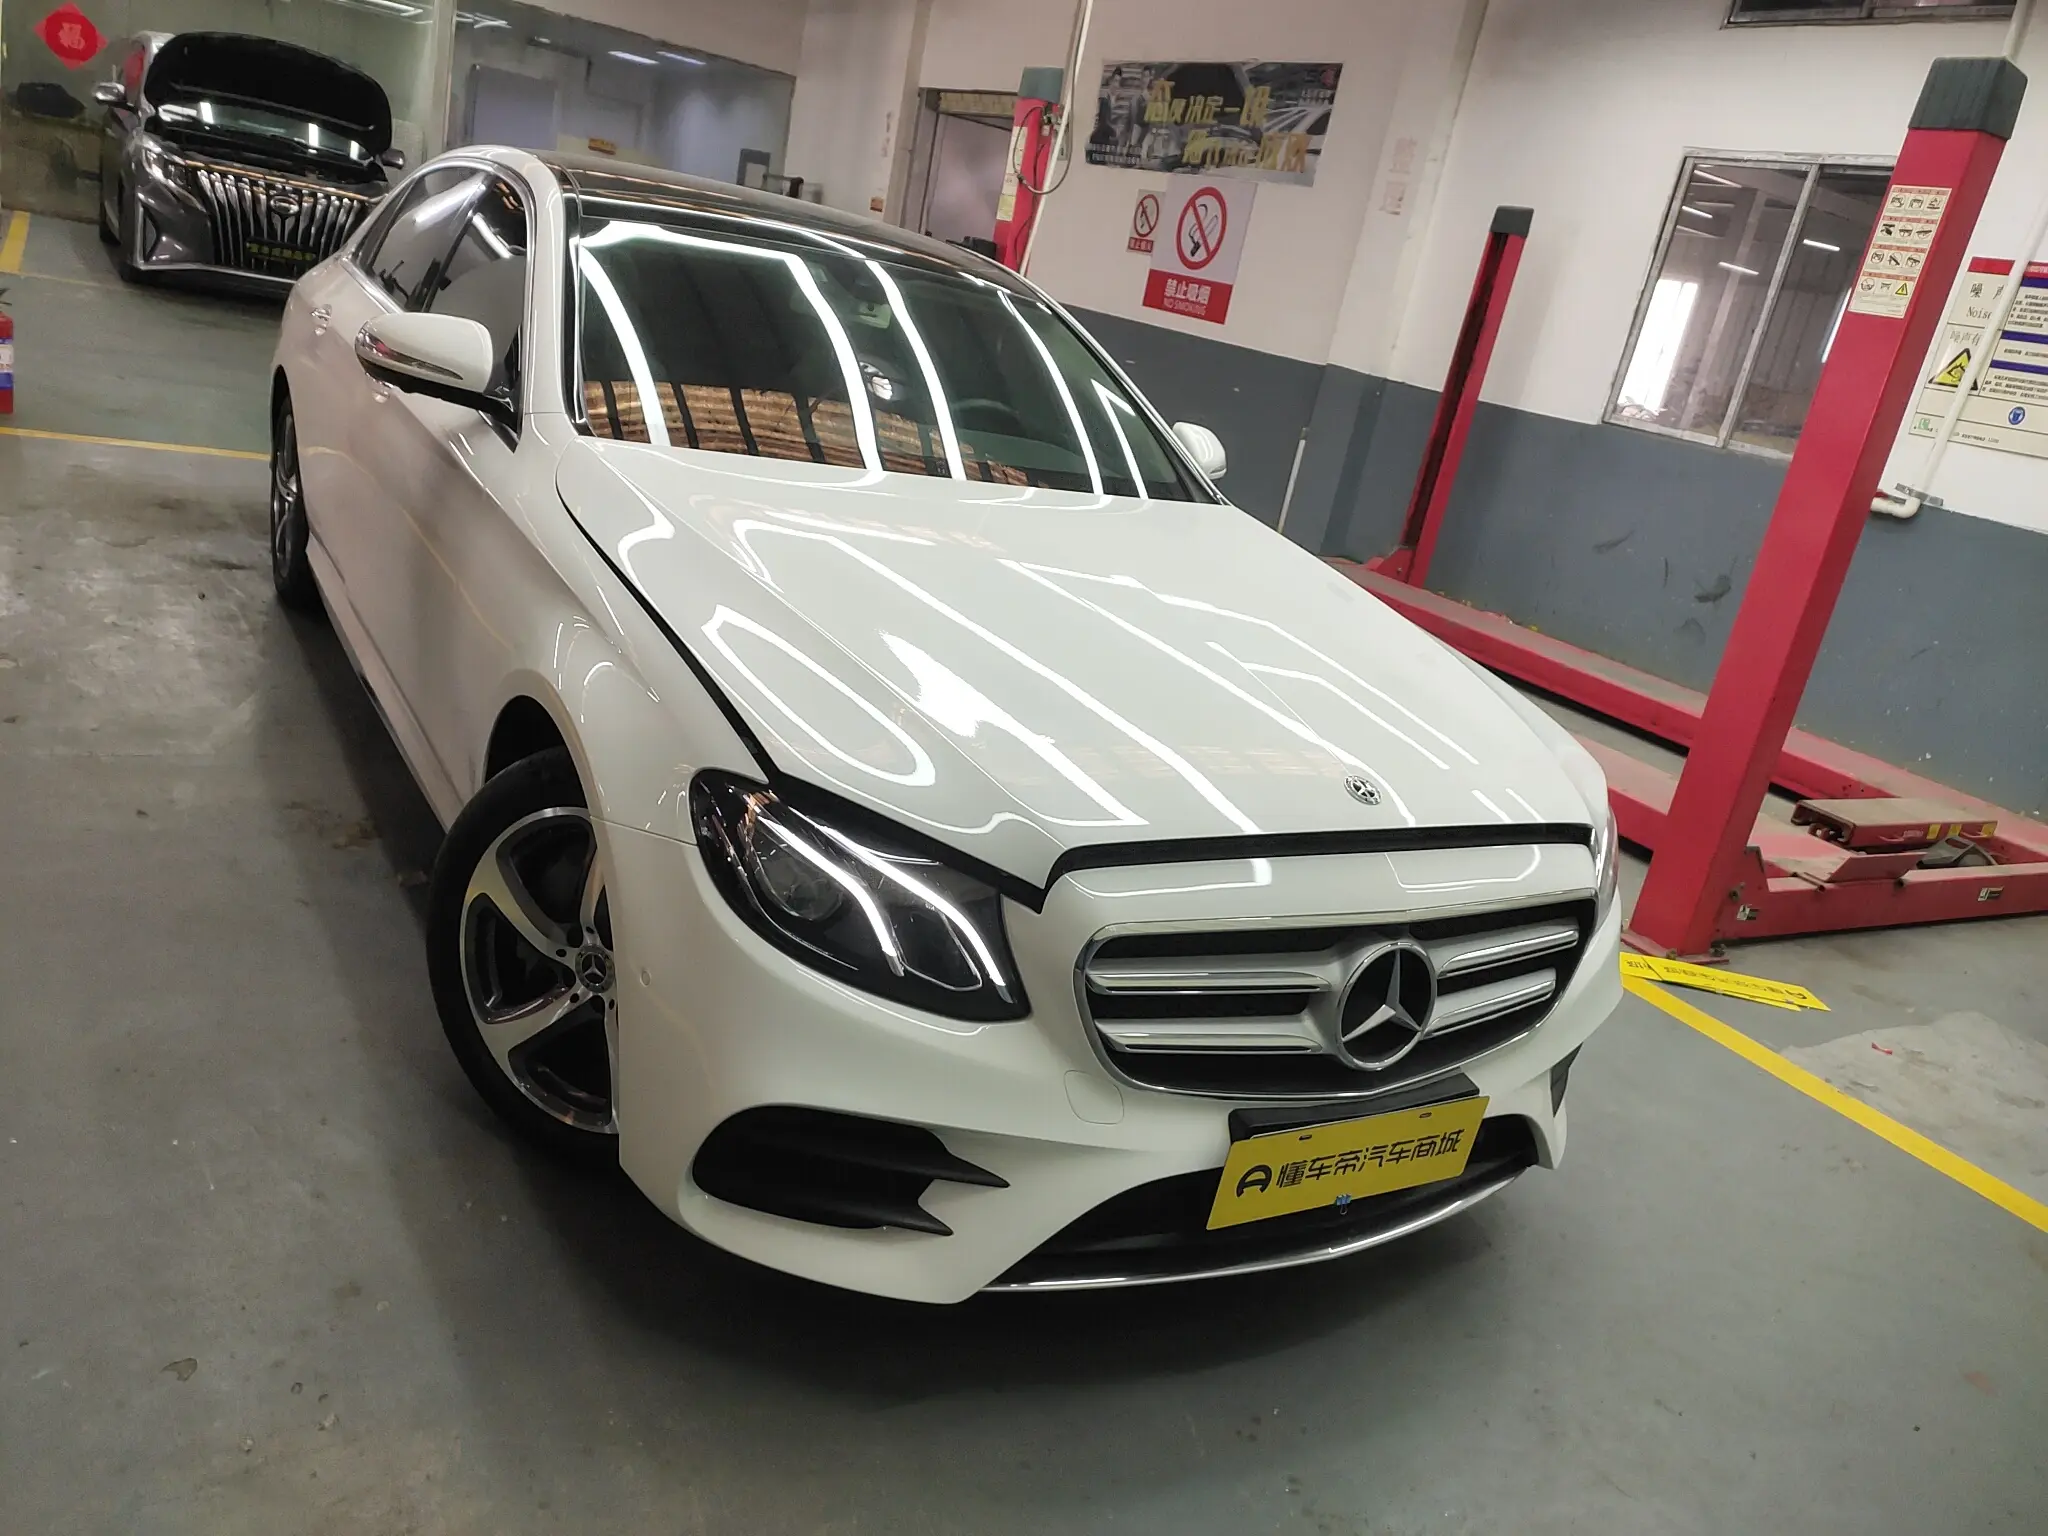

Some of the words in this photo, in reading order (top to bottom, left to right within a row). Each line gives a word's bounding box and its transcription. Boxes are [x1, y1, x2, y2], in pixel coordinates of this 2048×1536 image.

[57, 22, 86, 51] 福
[1164, 278, 1212, 304] 禁止吸烟
[1163, 297, 1175, 309] NO
[1175, 300, 1207, 316] SMOKING
[1276, 1128, 1465, 1188] 懂车帝汽车商城
